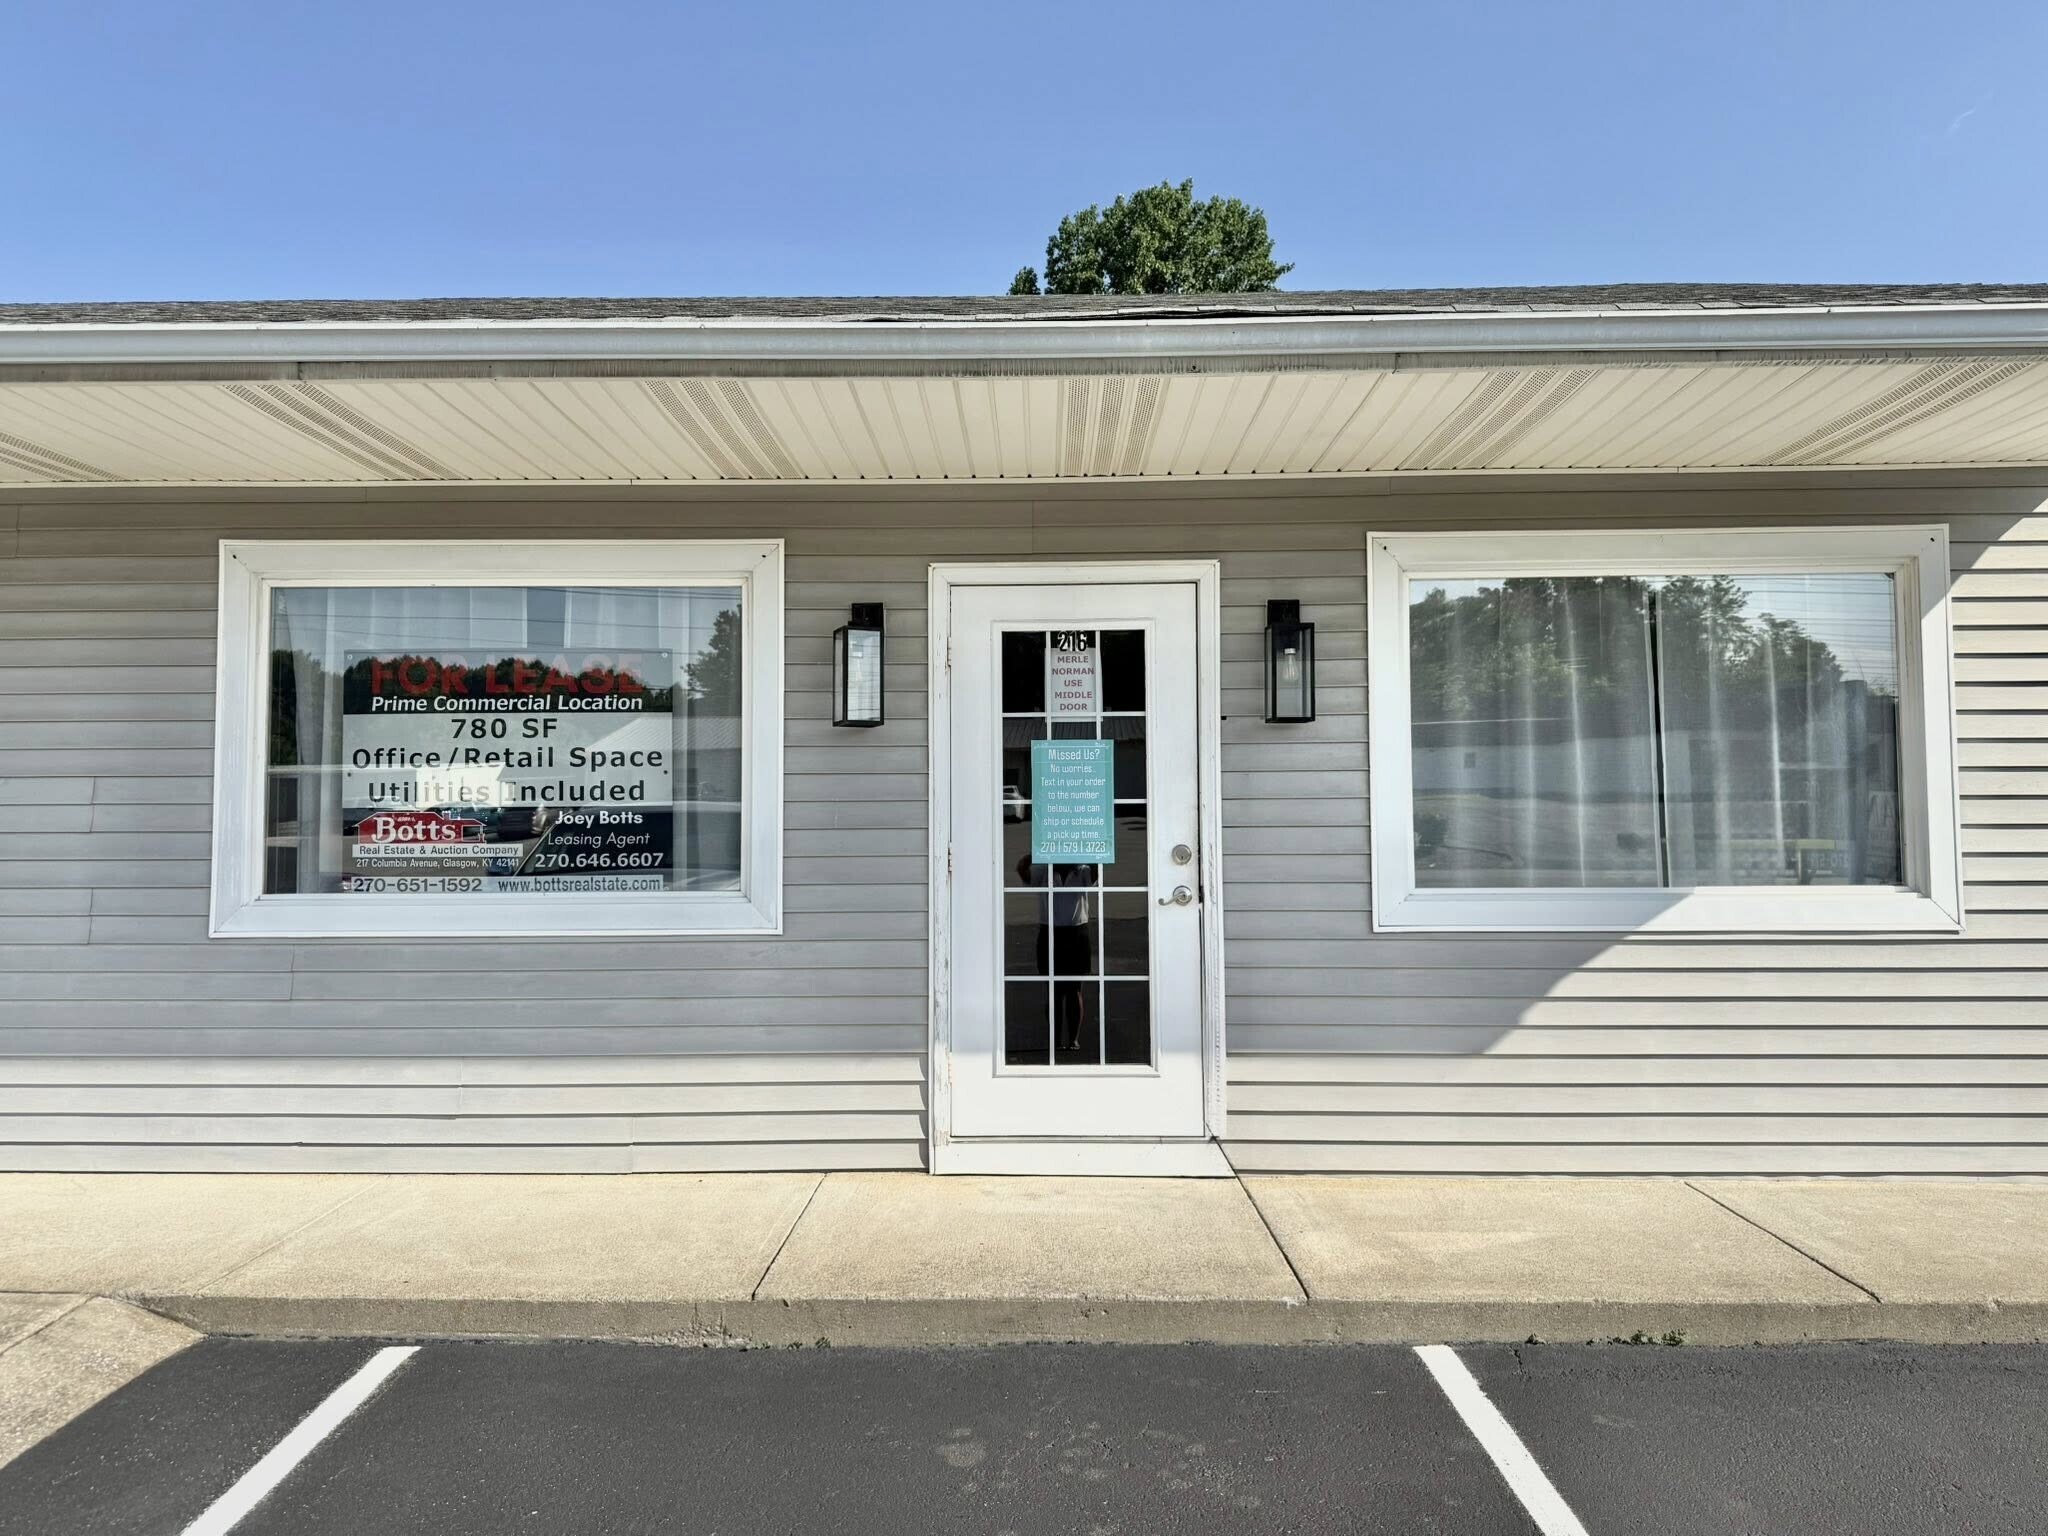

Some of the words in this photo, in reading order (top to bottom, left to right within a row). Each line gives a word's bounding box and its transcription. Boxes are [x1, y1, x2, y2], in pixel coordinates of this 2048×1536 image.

[1057, 630, 1088, 652] 216
[1057, 655, 1089, 664] MERLE
[371, 654, 469, 695] FOR
[486, 653, 643, 694] LEASE
[1052, 667, 1095, 676] NORMAN
[1064, 679, 1083, 687] USE
[1055, 691, 1093, 699] MIDDLE
[371, 695, 428, 712] Prime
[433, 695, 551, 712] Commercial
[558, 694, 643, 711] Location
[1060, 703, 1088, 711] DOOR
[451, 718, 507, 739] 780
[522, 718, 558, 739] SF
[569, 746, 663, 772] Space
[1048, 748, 1081, 760] Missed
[1083, 748, 1100, 760] Us?
[1050, 764, 1060, 773] No
[1041, 777, 1056, 787] Text
[1057, 777, 1065, 786] in
[1066, 778, 1083, 787] your
[1084, 777, 1106, 786] order
[368, 781, 490, 803] Utilities
[505, 780, 645, 802] Included
[1048, 791, 1056, 800] to
[1057, 790, 1069, 799] the
[1070, 790, 1100, 799] number
[1074, 804, 1086, 812] we
[1087, 804, 1100, 812] can
[555, 810, 595, 828] Joey
[599, 810, 644, 825] Botts
[1043, 817, 1059, 826] ship
[1060, 818, 1070, 826] or
[1071, 817, 1105, 826] schedule
[371, 816, 456, 843] Botts
[1047, 831, 1052, 839] a
[1053, 830, 1069, 840] pick
[1070, 831, 1080, 840] up
[548, 832, 602, 849] Leasing
[606, 832, 651, 848] Agent
[359, 845, 380, 855] Real
[384, 845, 415, 855] Estate
[420, 846, 426, 855] &
[430, 845, 468, 855] Auction
[472, 845, 519, 857] Company
[1041, 841, 1056, 853] 270
[1063, 841, 1078, 853] 579
[1085, 841, 1106, 853] 3723
[356, 859, 369, 868] 217
[371, 858, 407, 868] Columbia
[409, 858, 440, 868] Avenue,
[442, 858, 479, 869] Glasgow,
[482, 858, 493, 867] KY
[496, 858, 519, 867] 42141
[535, 852, 664, 868] 270.646.6607
[354, 878, 482, 892] 270-651-1592
[498, 876, 660, 892] www.bottsrealstate.com
